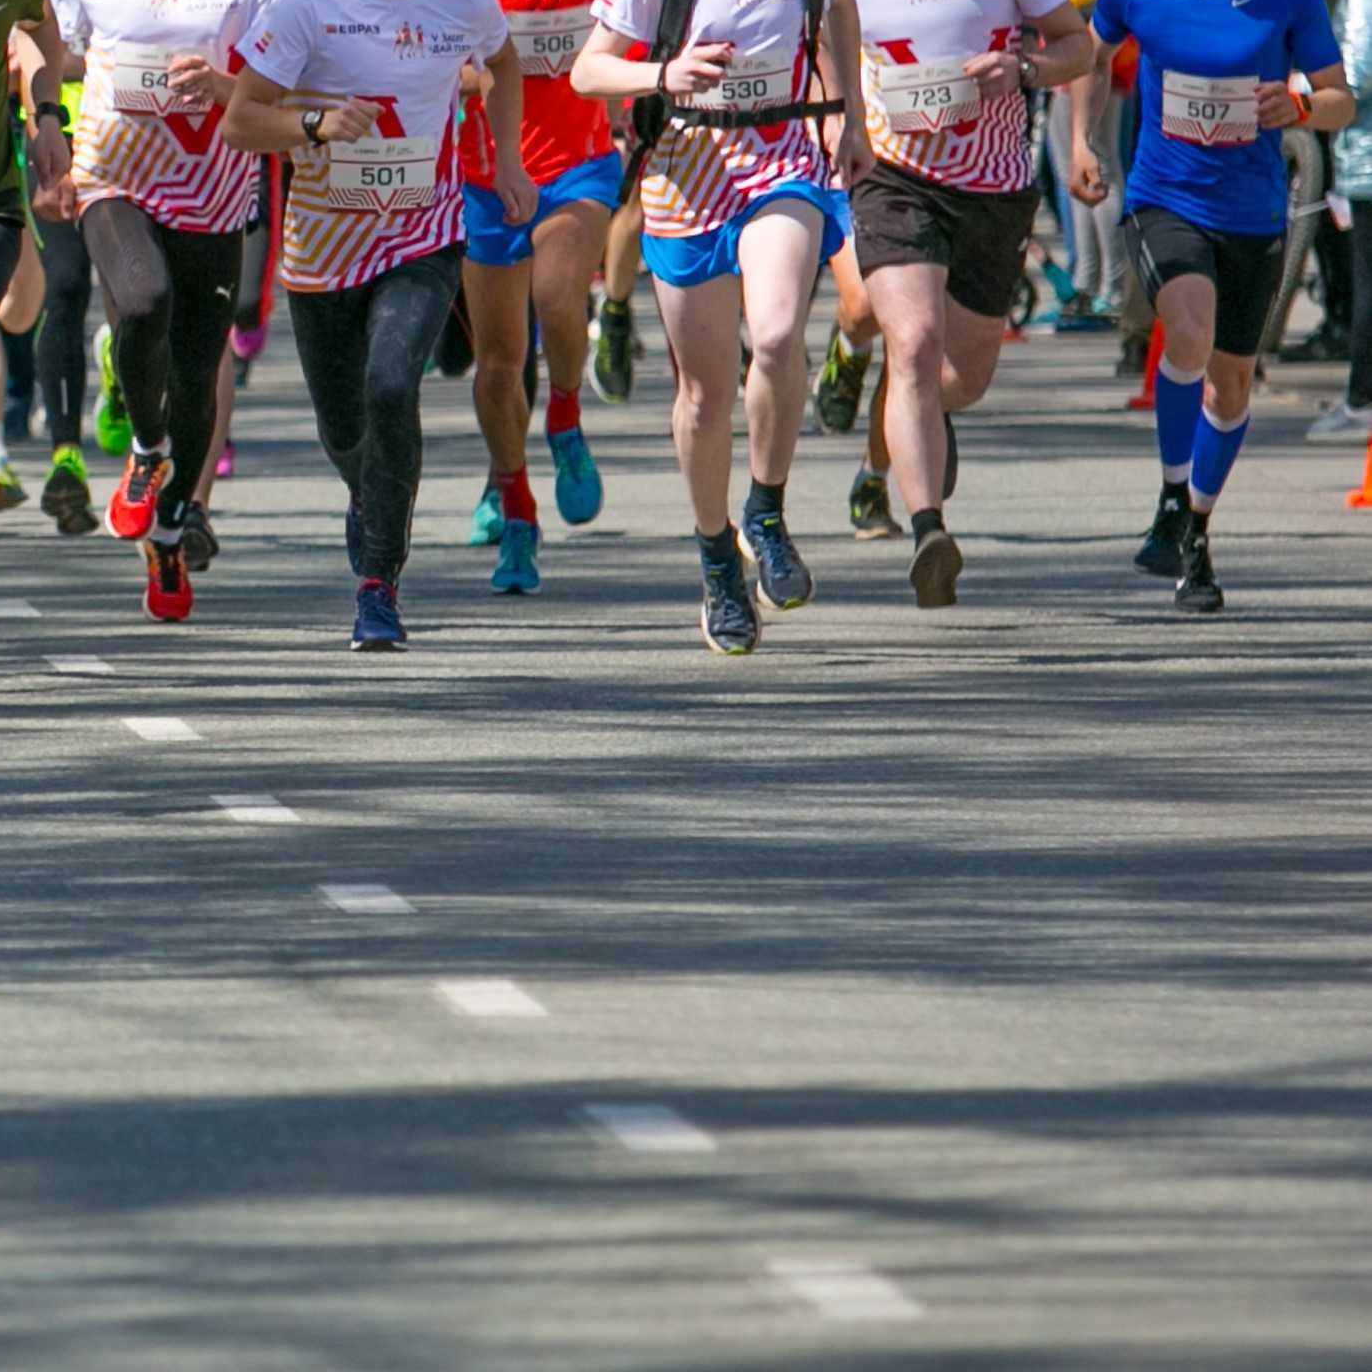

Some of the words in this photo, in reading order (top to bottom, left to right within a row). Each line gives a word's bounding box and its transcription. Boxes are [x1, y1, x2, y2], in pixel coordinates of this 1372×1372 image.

[338, 23, 381, 35] ЕВРАЗ
[532, 34, 575, 53] 506
[141, 70, 169, 88] 64
[721, 79, 768, 100] 530
[907, 85, 953, 108] 723
[1186, 100, 1231, 121] 507
[360, 165, 407, 187] 501
